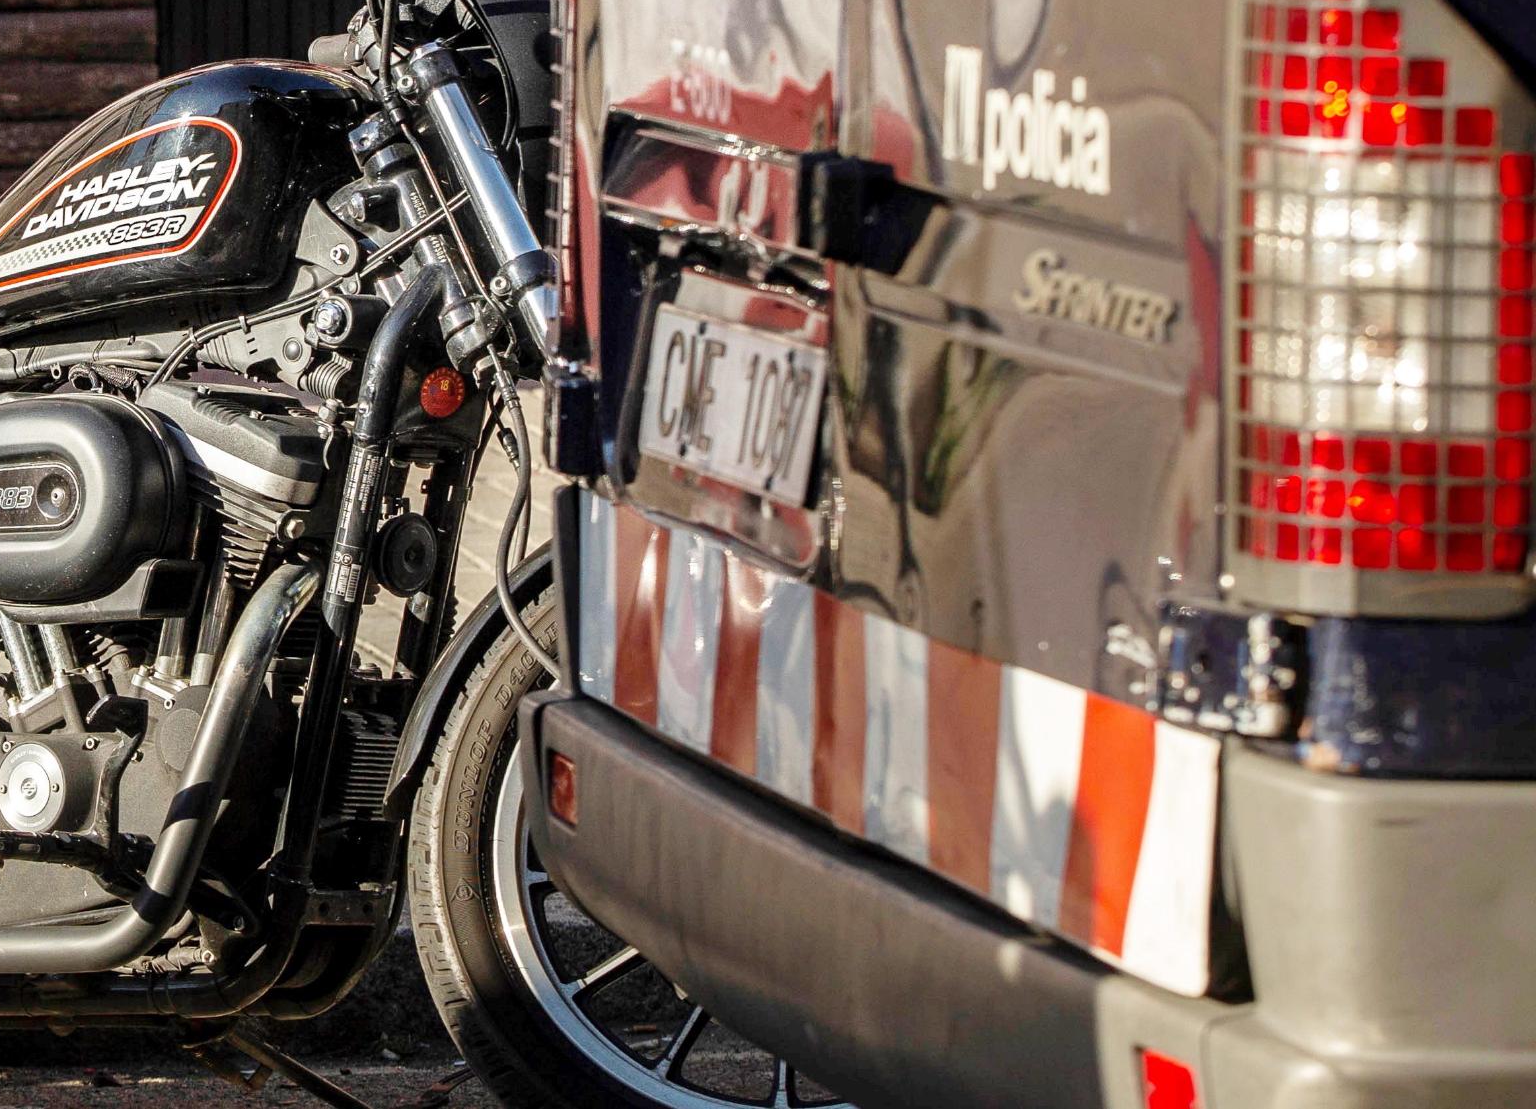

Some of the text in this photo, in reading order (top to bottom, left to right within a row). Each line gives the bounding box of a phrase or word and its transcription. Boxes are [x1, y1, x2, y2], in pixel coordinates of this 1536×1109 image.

[56, 152, 217, 207] HARLEY-
[983, 68, 1111, 196] policia
[22, 176, 210, 240] DAVIDSON
[108, 215, 185, 244] 883R
[738, 353, 812, 480] 1087
[454, 719, 495, 853] DUNLOP
